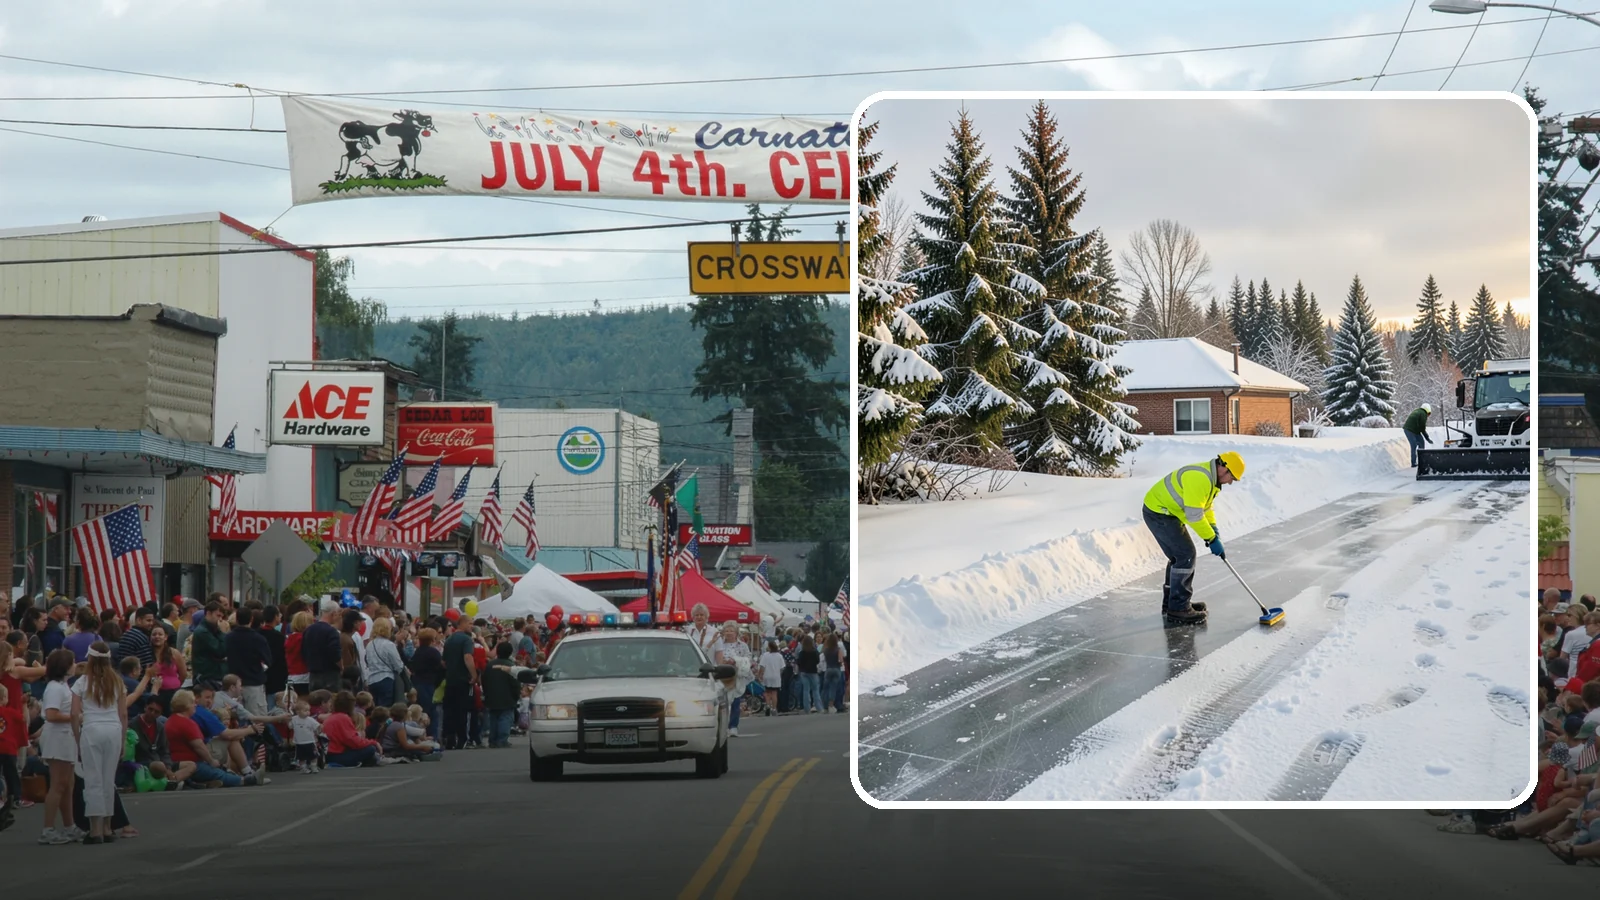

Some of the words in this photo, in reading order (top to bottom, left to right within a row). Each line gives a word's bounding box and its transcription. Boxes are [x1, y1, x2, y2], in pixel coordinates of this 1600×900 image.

[693, 121, 850, 150] Carnat
[481, 141, 605, 193] JULY
[632, 150, 747, 198] 4th.
[697, 254, 850, 280] CROSSWA
[282, 380, 374, 420] ACE
[406, 409, 453, 422] CEDAR
[283, 421, 371, 436] Hardware
[354, 467, 386, 482] Simpl
[95, 485, 124, 495] Vincent
[126, 486, 137, 495] de
[138, 486, 155, 495] Paul
[81, 503, 154, 522] THT
[688, 526, 741, 535] CRNATION
[699, 535, 730, 543] GLASS
